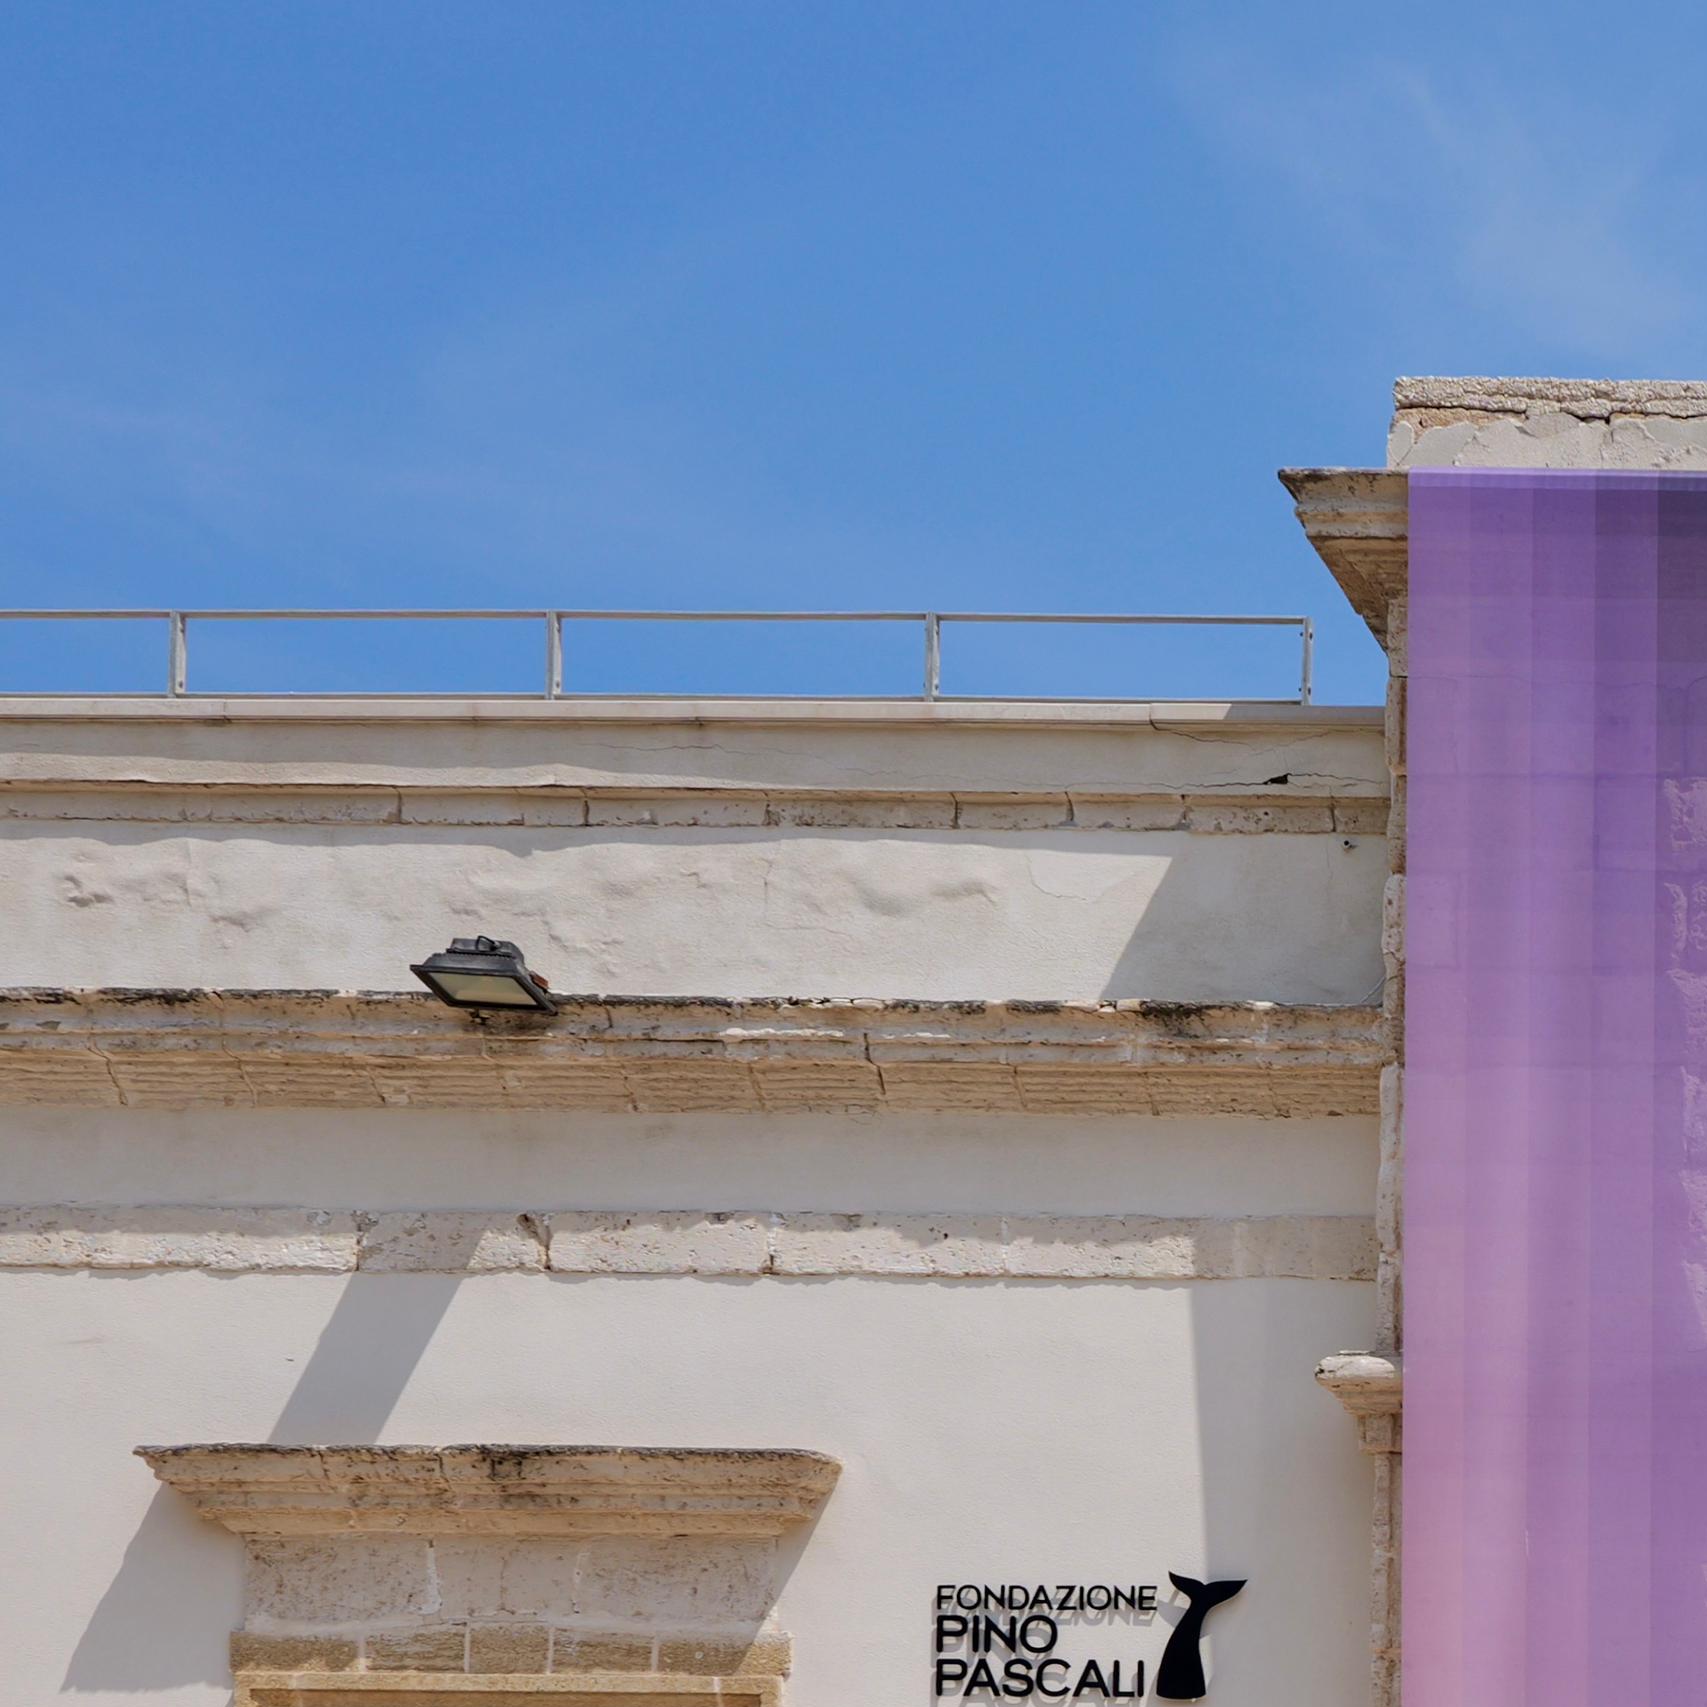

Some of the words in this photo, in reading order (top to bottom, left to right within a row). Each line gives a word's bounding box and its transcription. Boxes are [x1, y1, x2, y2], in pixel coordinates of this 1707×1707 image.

[936, 1584, 1158, 1611] FONDAZIONE
[936, 1615, 1058, 1654] PINO
[935, 1658, 1145, 1698] PASCALI
